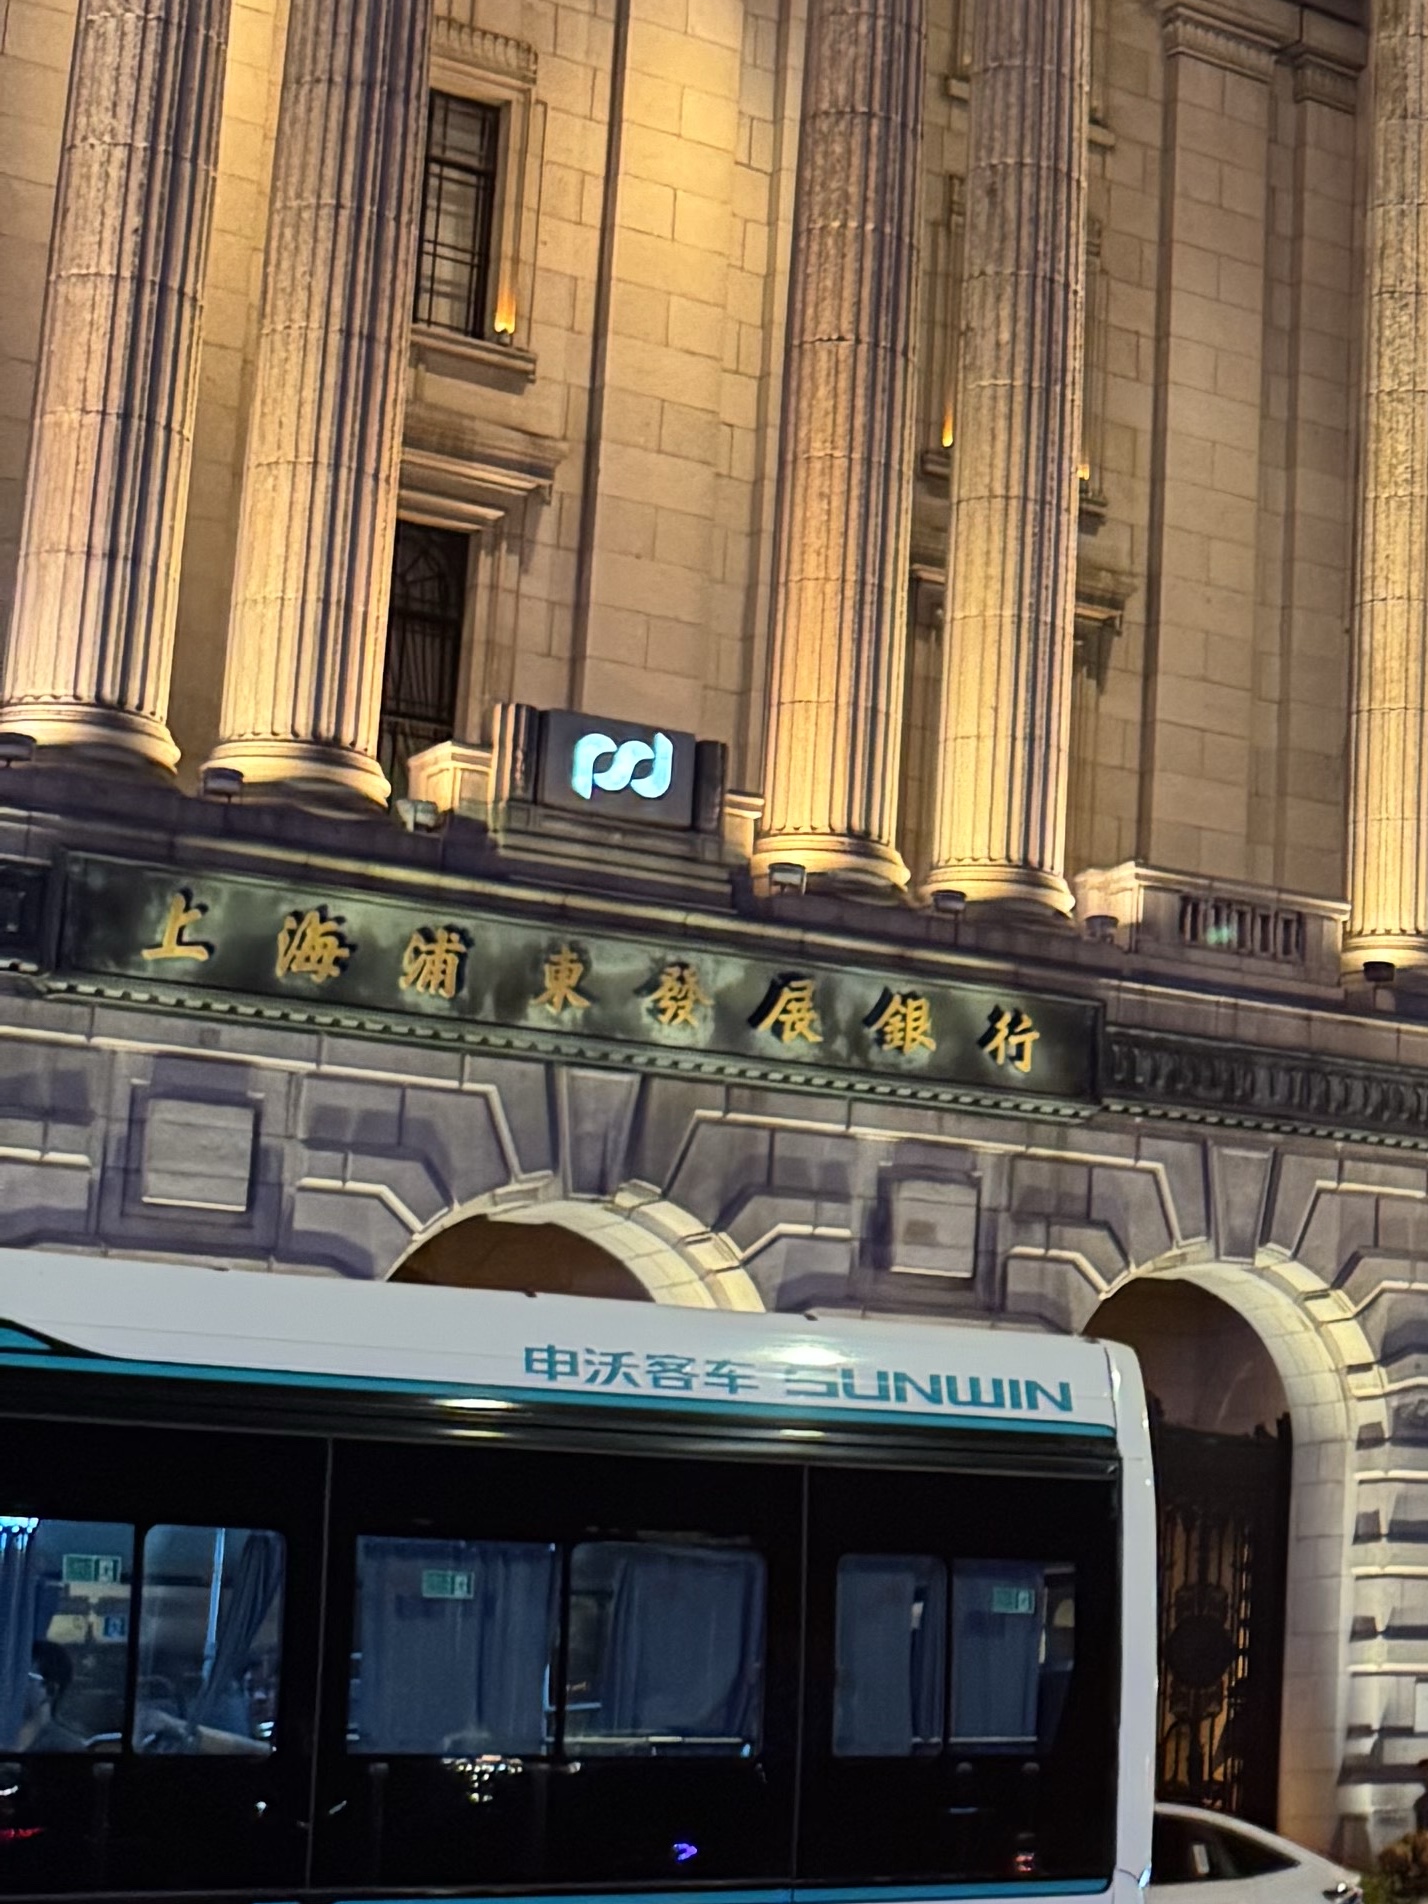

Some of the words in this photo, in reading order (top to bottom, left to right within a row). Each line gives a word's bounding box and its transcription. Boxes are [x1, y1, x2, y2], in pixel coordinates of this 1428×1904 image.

[141, 894, 1040, 1073] 上海浦東發展銀行
[523, 1343, 760, 1395] 申沃客车
[785, 1368, 1074, 1412] SUNWIN
